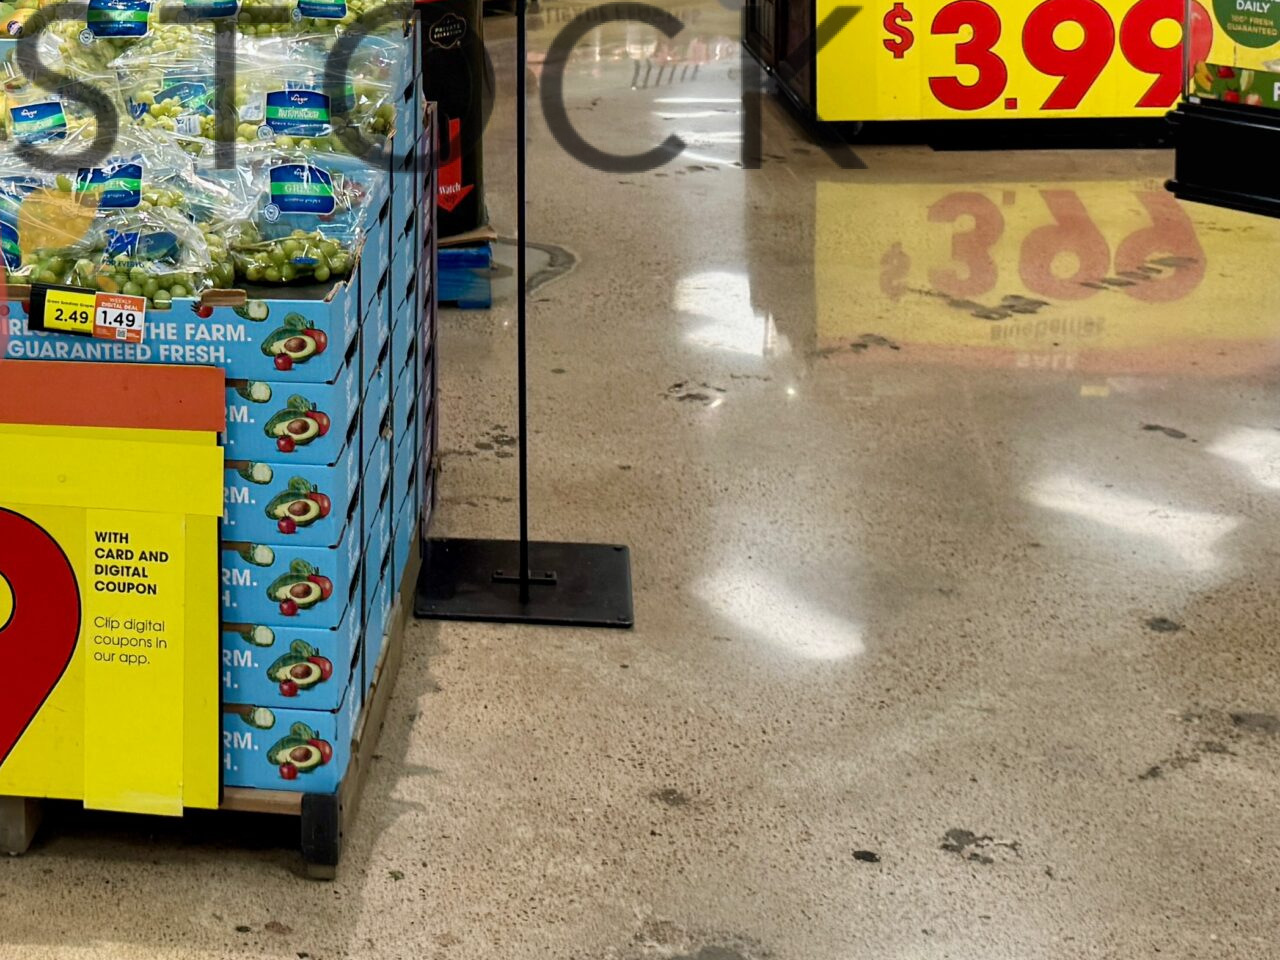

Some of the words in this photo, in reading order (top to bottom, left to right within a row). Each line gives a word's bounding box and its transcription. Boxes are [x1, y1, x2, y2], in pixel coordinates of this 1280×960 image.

[1236, 0, 1271, 14] DAILY
[1249, 14, 1274, 26] FRESH
[1226, 21, 1278, 37] GUARANTEED
[439, 182, 462, 195] Watch
[54, 308, 89, 325] 2.49
[101, 310, 136, 328] 1.49
[143, 322, 177, 340] THE
[185, 323, 253, 343] FARM.
[7, 340, 152, 362] GUARANTEED
[159, 343, 233, 364] FRESH.
[94, 530, 130, 544] WITH
[94, 547, 135, 561] CARD
[138, 550, 170, 563] AND
[94, 564, 149, 579] DIGITAL
[94, 580, 158, 595] COUPON
[93, 616, 120, 632] Clip
[123, 618, 166, 633] digital
[93, 635, 153, 649] coupons
[155, 636, 168, 649] in
[93, 651, 116, 662] our
[118, 652, 151, 667] app.
